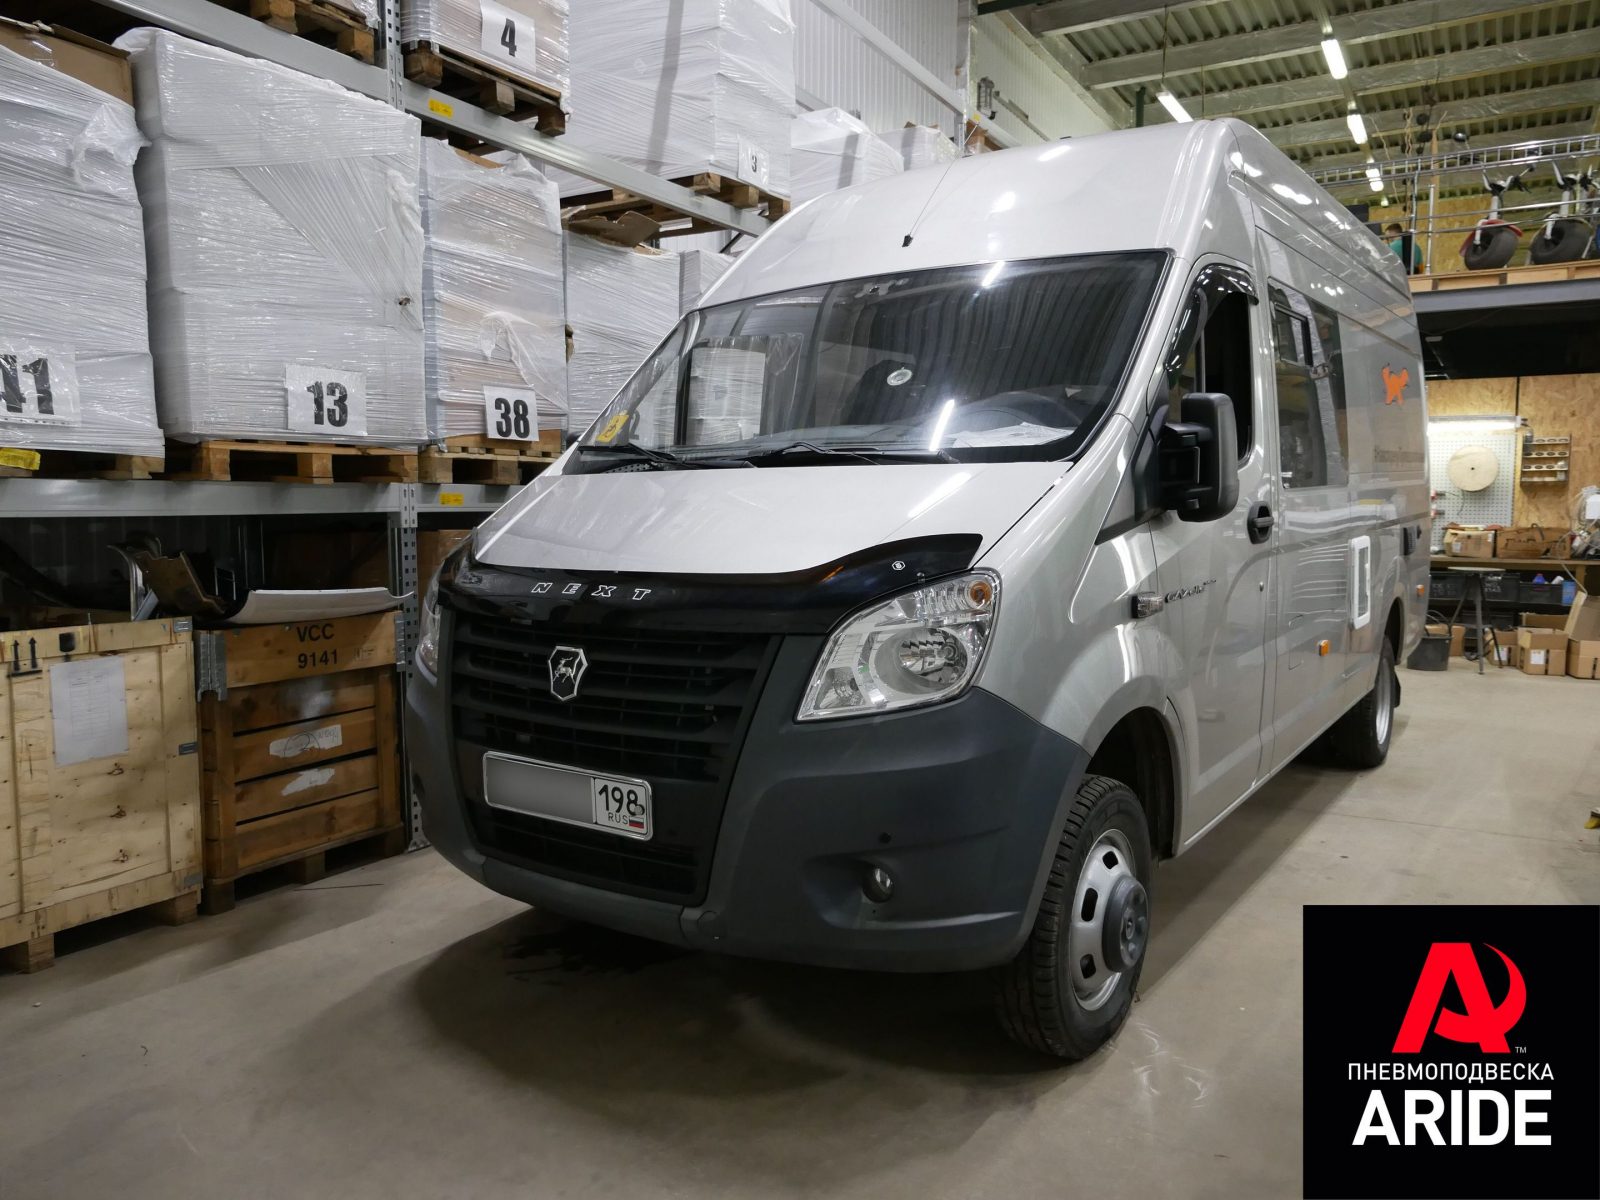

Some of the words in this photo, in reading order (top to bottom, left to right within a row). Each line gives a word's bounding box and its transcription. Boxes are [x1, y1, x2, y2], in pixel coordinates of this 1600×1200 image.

[501, 18, 517, 57] 4
[752, 155, 757, 173] 3
[306, 381, 348, 427] 13
[495, 398, 530, 439] 38
[531, 582, 652, 600] NEXT
[297, 623, 335, 642] VCC
[298, 649, 338, 669] 9141
[598, 784, 638, 816] 198
[608, 812, 628, 825] RUS
